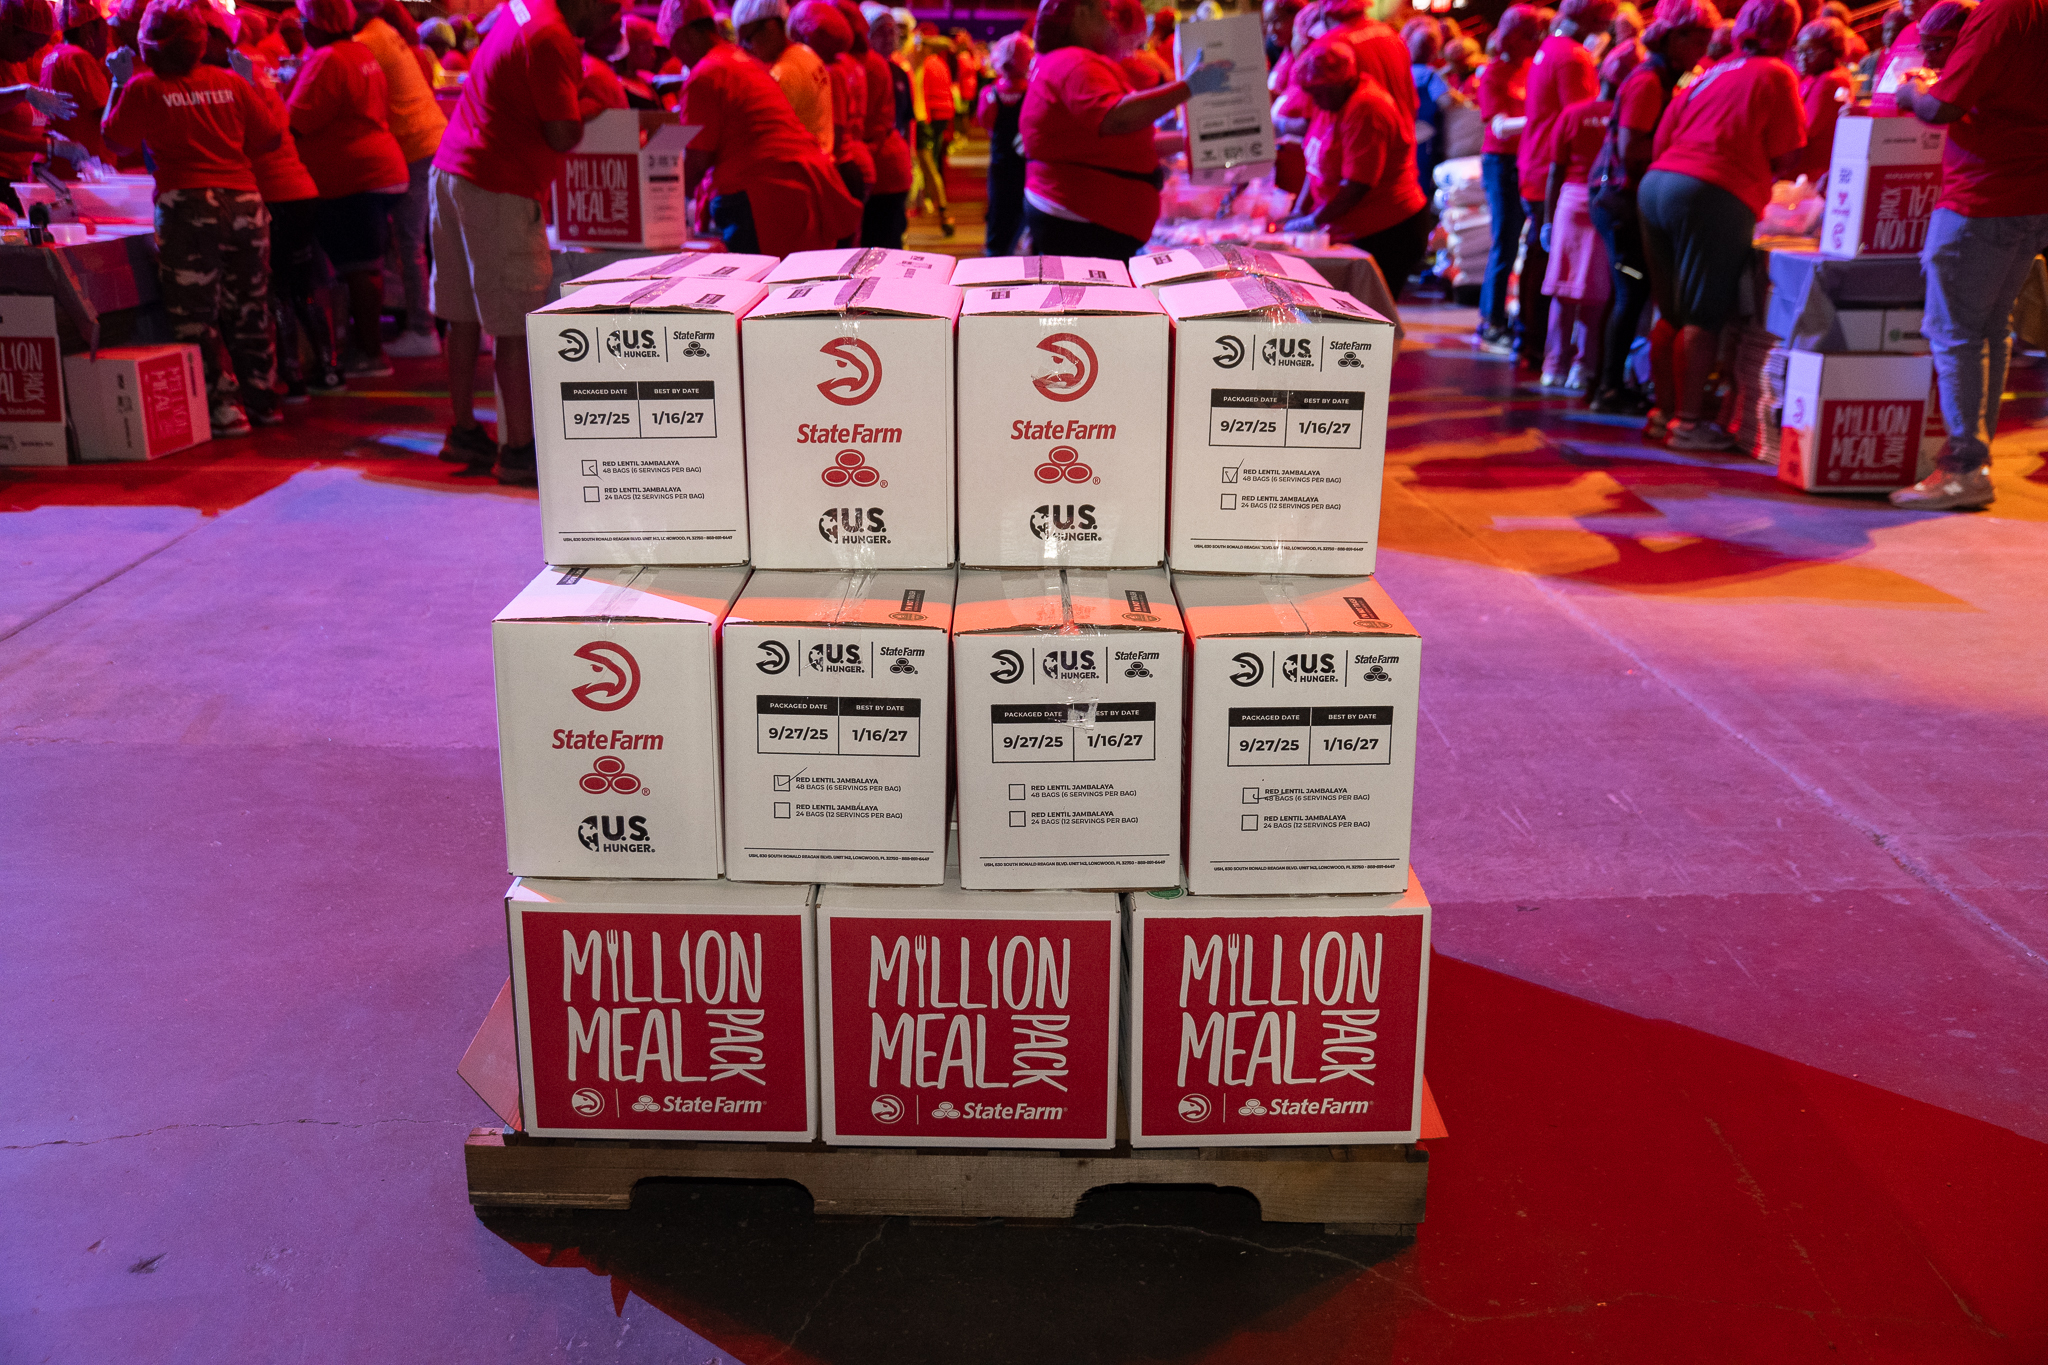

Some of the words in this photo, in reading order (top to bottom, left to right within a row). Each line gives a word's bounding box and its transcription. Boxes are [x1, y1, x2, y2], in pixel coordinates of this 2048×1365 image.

[162, 89, 234, 107] VOLUNTEER
[566, 158, 628, 190] MILLION
[567, 191, 612, 223] MEAL
[573, 411, 630, 425] 9/27/25
[652, 410, 704, 424] 1/16/27
[1220, 418, 1276, 433] 9/27/25
[1298, 420, 1351, 435] 1/16/27
[1832, 404, 1911, 436] MILLION
[1829, 435, 1882, 468] MEAL
[768, 725, 828, 741] 9/27/25
[852, 727, 907, 742] 1/16/27
[1003, 733, 1063, 748] 9/27/25
[1086, 732, 1142, 747] 1/16/27
[1238, 737, 1299, 752] 9/27/25
[1322, 736, 1379, 751] 1/16/27
[562, 929, 762, 1004] MILLION
[868, 934, 1070, 1010] MILLION
[1179, 931, 1383, 1007] MILLION
[567, 1006, 708, 1082] MEAL
[706, 1008, 766, 1086] PACK
[869, 1012, 1009, 1088] MEAL
[1011, 1014, 1070, 1092] PACK
[1177, 1011, 1317, 1087] MEAL
[1320, 1009, 1380, 1086] PACK
